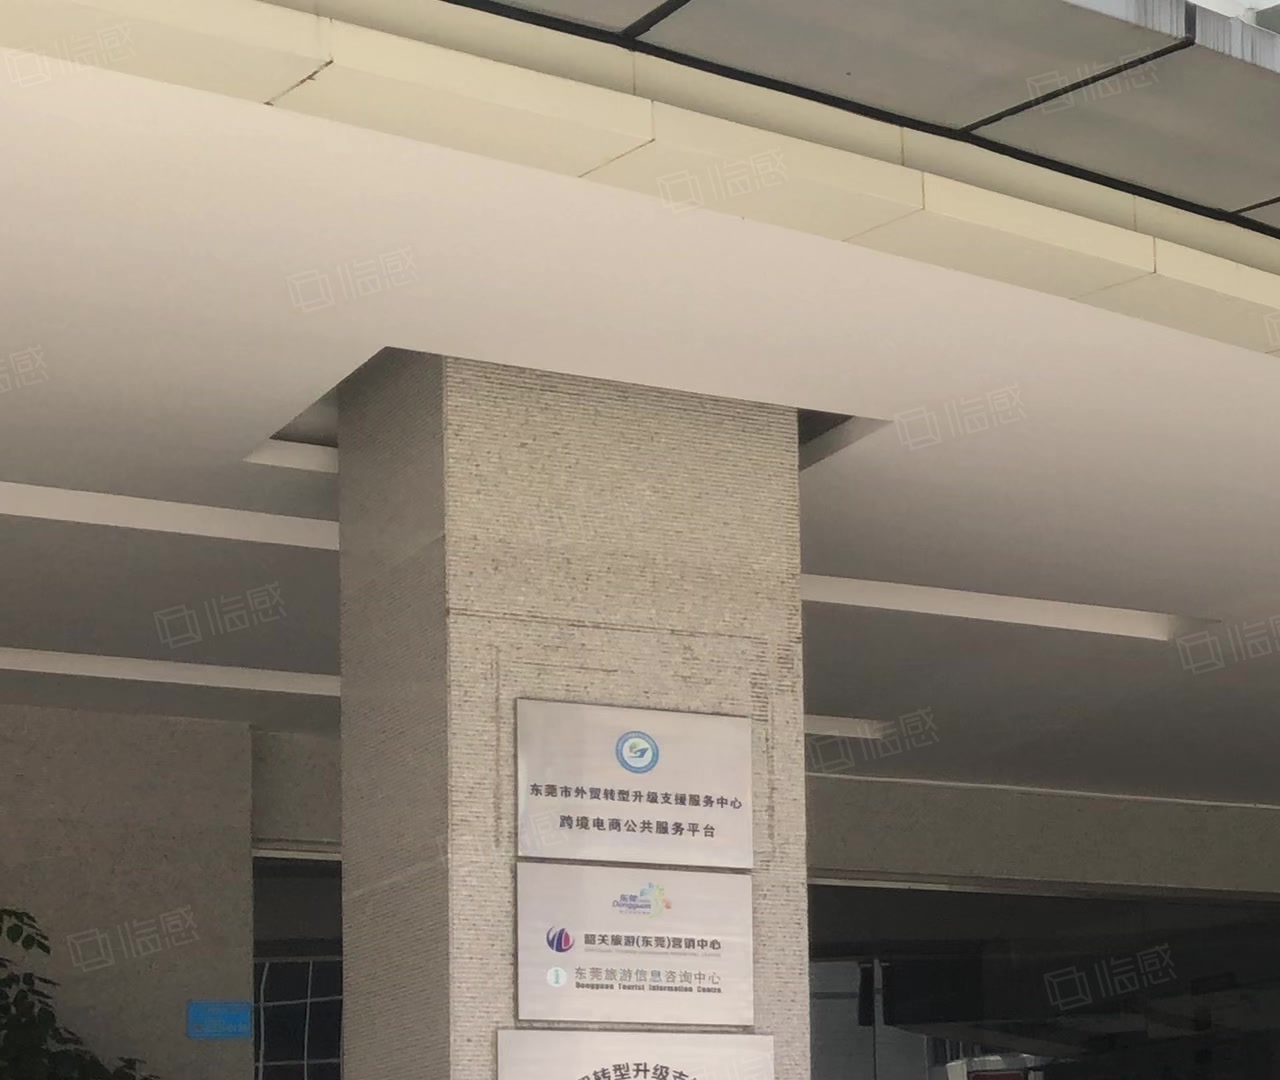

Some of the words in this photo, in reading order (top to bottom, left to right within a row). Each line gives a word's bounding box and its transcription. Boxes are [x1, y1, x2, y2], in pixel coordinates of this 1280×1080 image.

[559, 815, 716, 838] 跨境电商公共服务平台
[574, 967, 721, 985] 东莞旅游信息咨询中心
